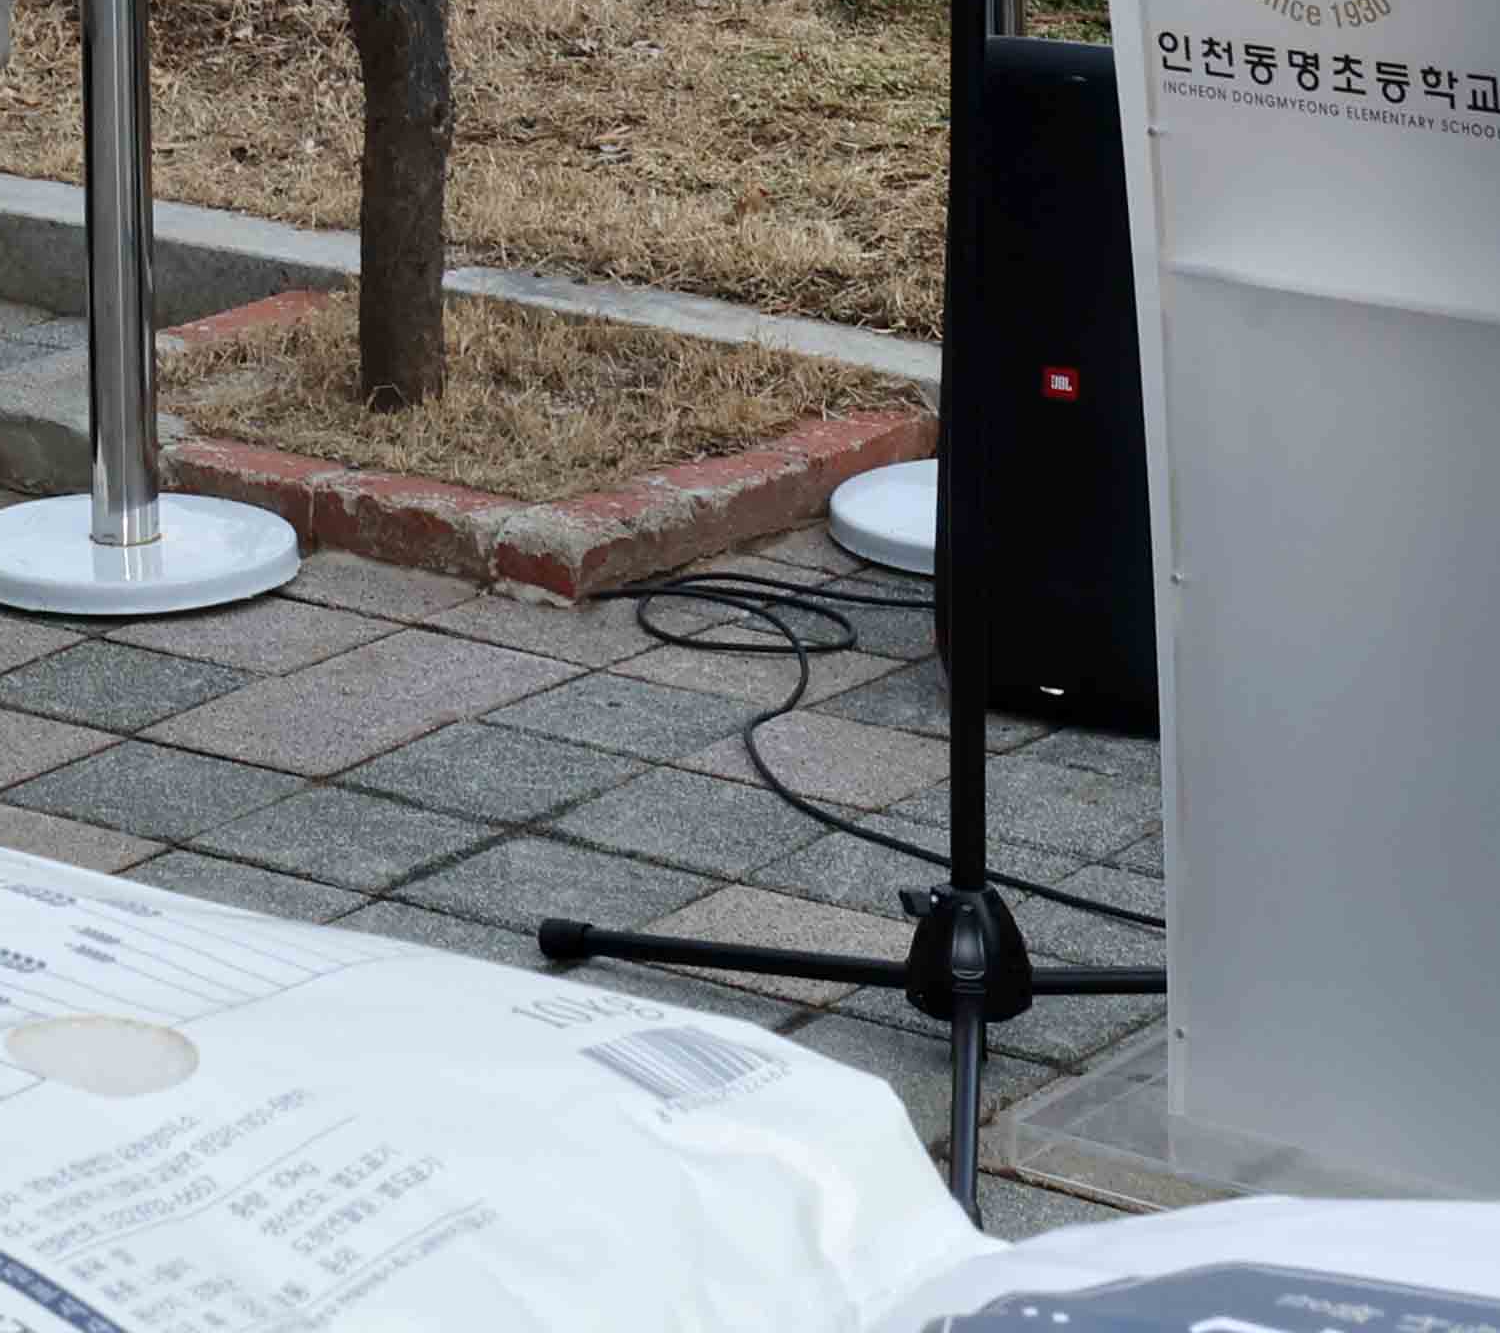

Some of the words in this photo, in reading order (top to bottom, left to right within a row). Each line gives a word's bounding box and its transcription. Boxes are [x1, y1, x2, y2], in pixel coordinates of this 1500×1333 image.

[1162, 81, 1228, 101] INCHEON
[1231, 90, 1340, 118] DONGMYEONG
[1345, 106, 1435, 131] ELEMENTARY
[1050, 373, 1073, 392] JBL
